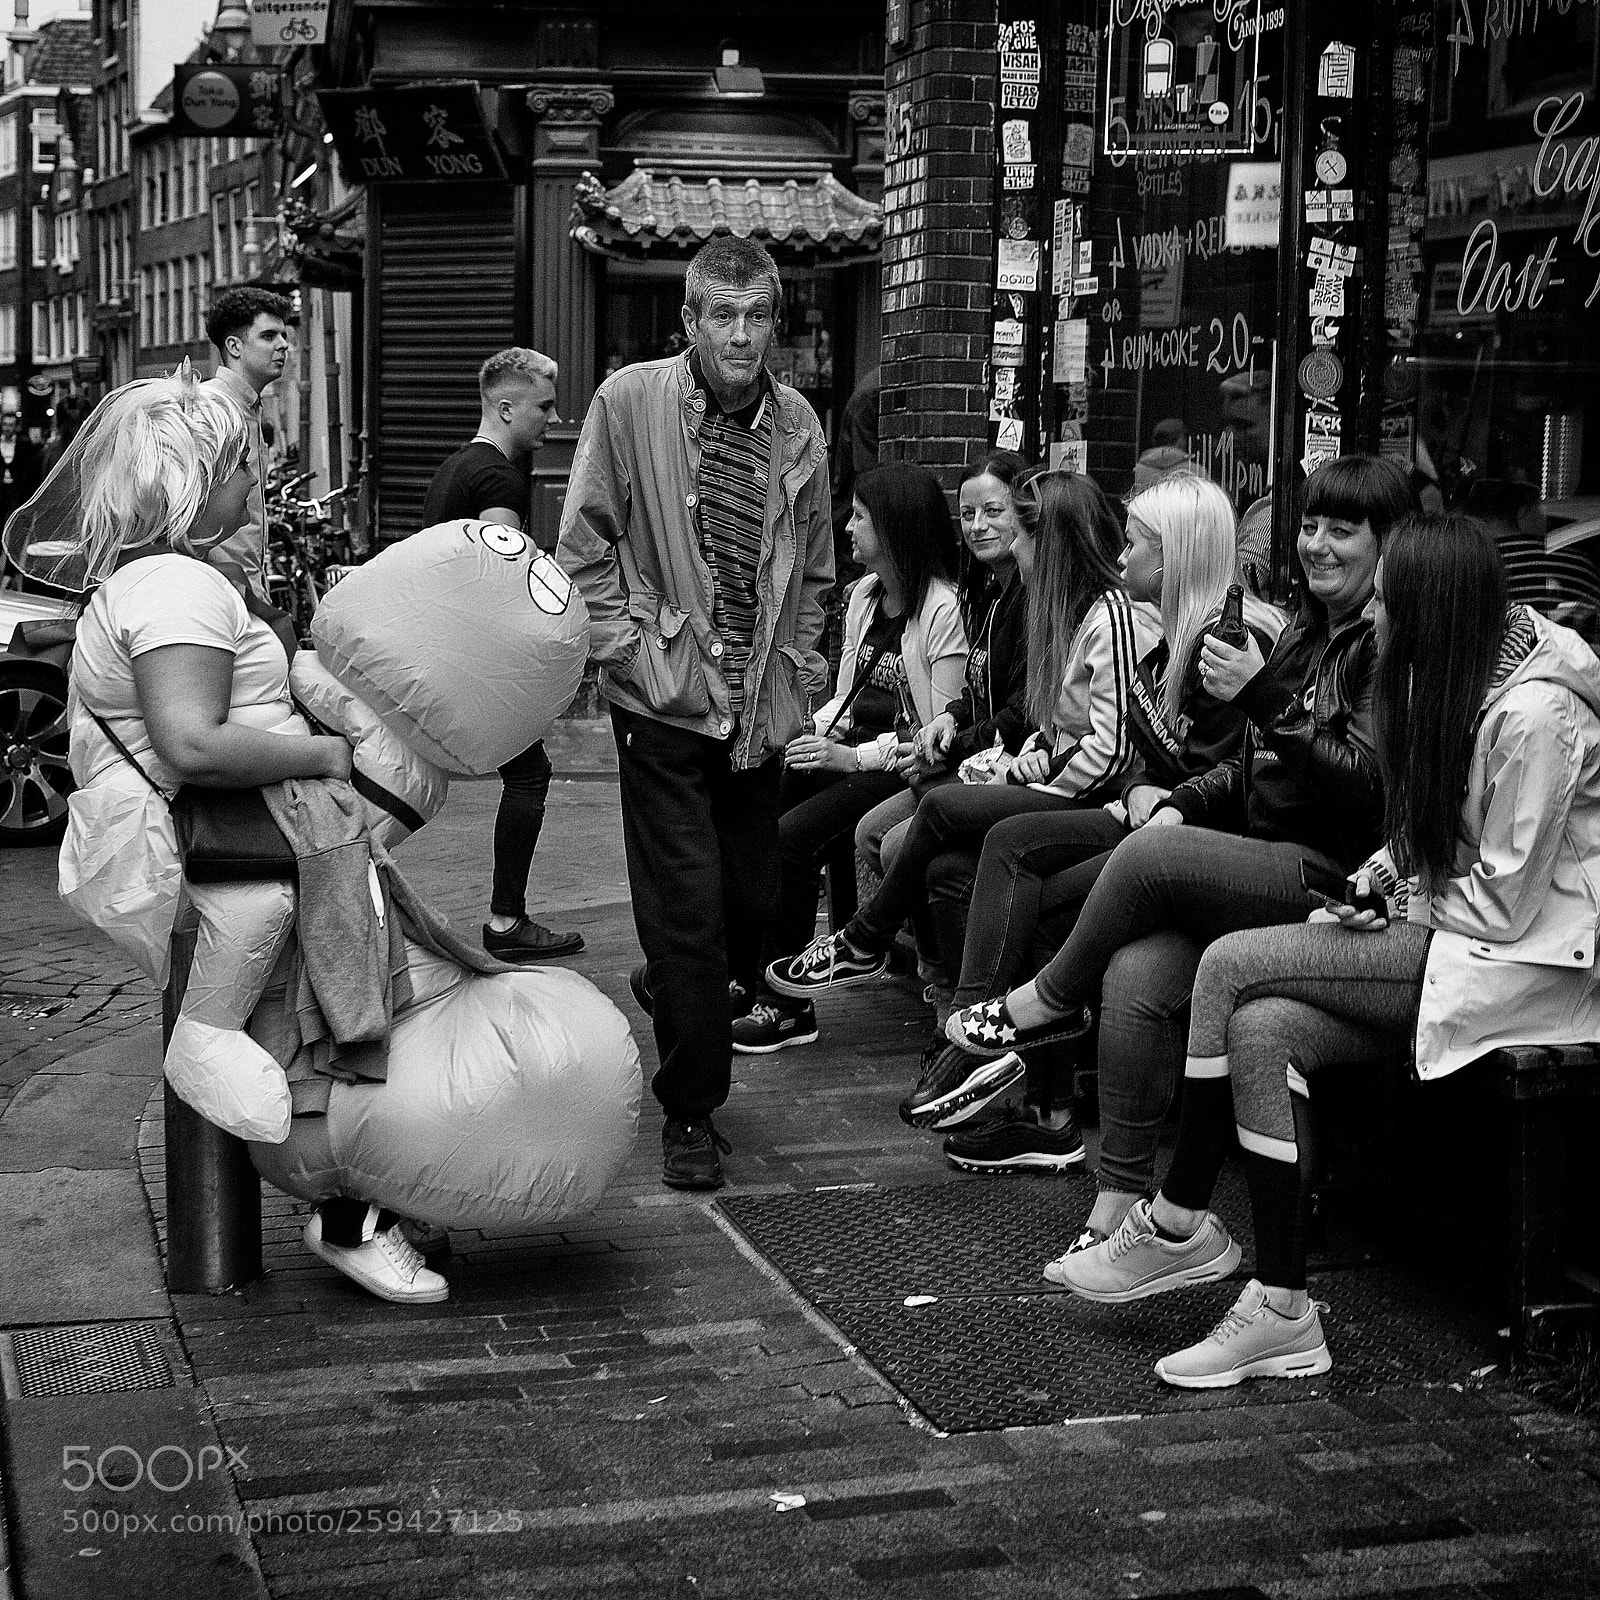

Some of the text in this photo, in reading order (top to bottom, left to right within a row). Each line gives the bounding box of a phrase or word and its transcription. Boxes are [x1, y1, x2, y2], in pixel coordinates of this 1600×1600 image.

[1265, 8, 1285, 31] 1899
[361, 153, 483, 176] DUN YONG
[1005, 166, 1034, 177] UTAH
[1137, 170, 1182, 197] BOTTLES
[1313, 274, 1326, 307] HERE
[1323, 278, 1334, 304] WAS
[1330, 274, 1343, 311] AWOL
[1102, 298, 1122, 323] OR
